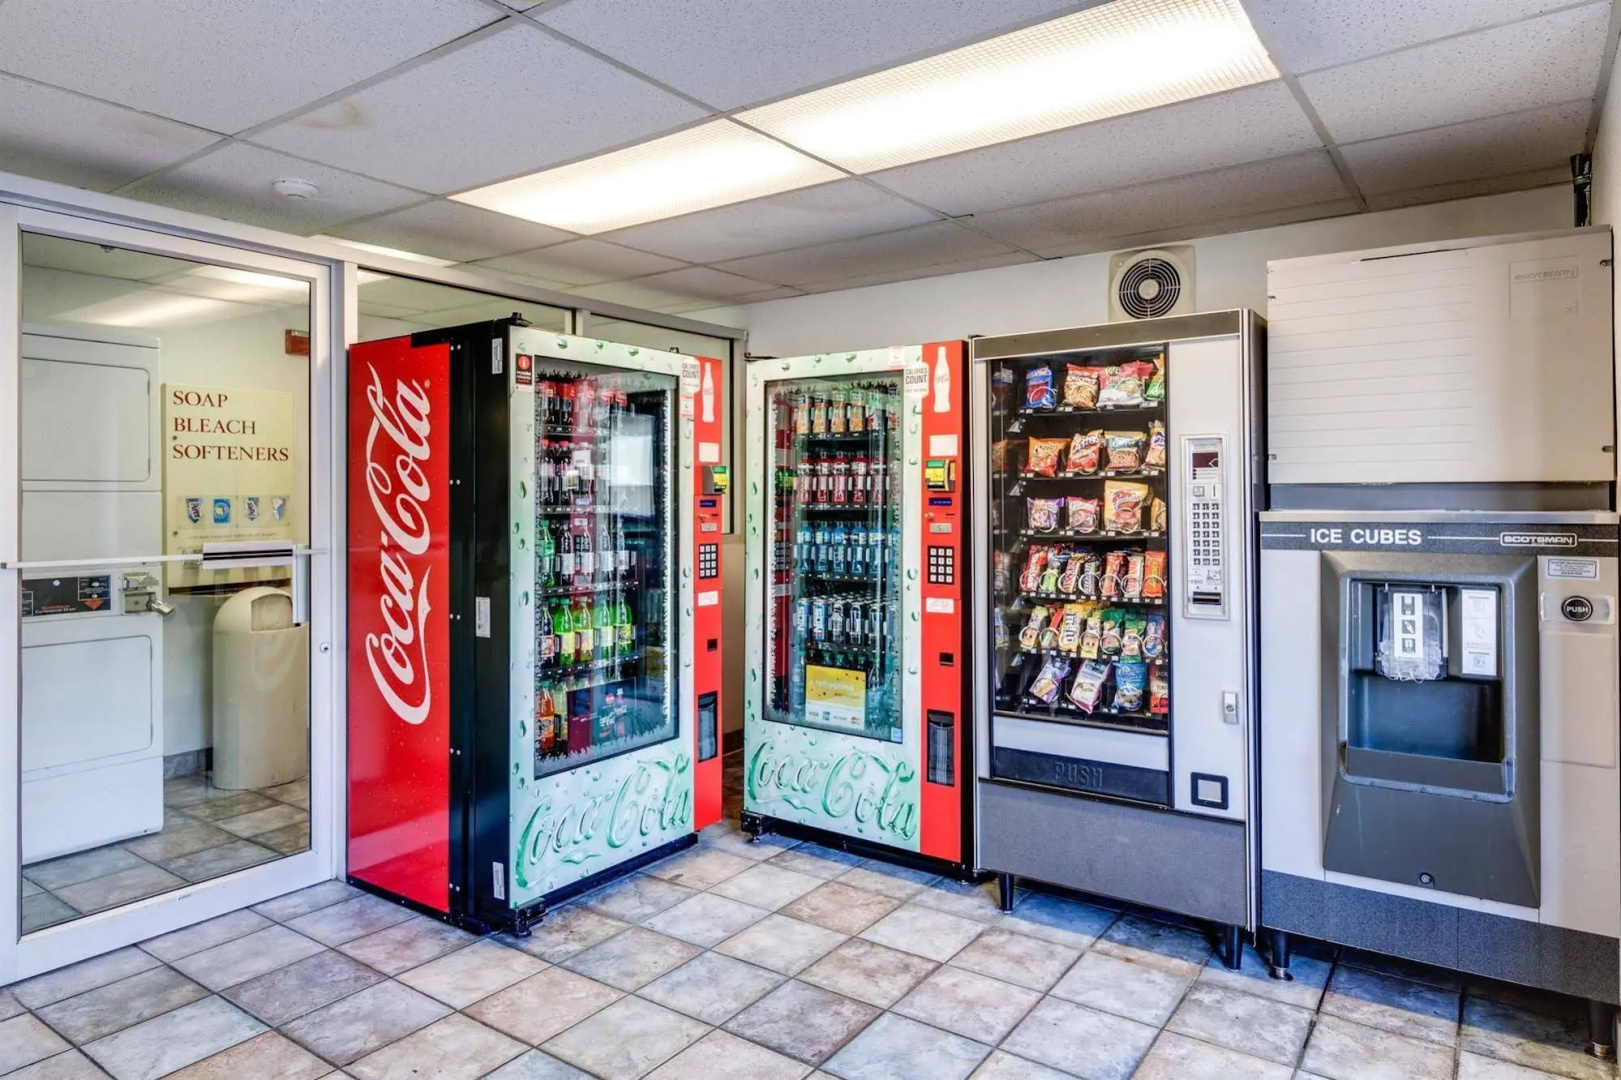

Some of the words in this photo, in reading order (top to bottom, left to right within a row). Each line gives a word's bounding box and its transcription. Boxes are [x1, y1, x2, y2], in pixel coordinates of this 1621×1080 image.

[905, 375, 927, 384] COUNT
[173, 390, 228, 408] SOAP
[173, 417, 256, 435] BLEACH
[172, 444, 289, 462] SOFTENERS
[366, 361, 432, 726] Coca-Cola
[1310, 528, 1342, 544] ICE
[1350, 529, 1422, 546] CUBES
[1503, 535, 1573, 546] SCOTSMAN
[1566, 605, 1589, 613] PUSH
[1051, 760, 1103, 787] PUSH
